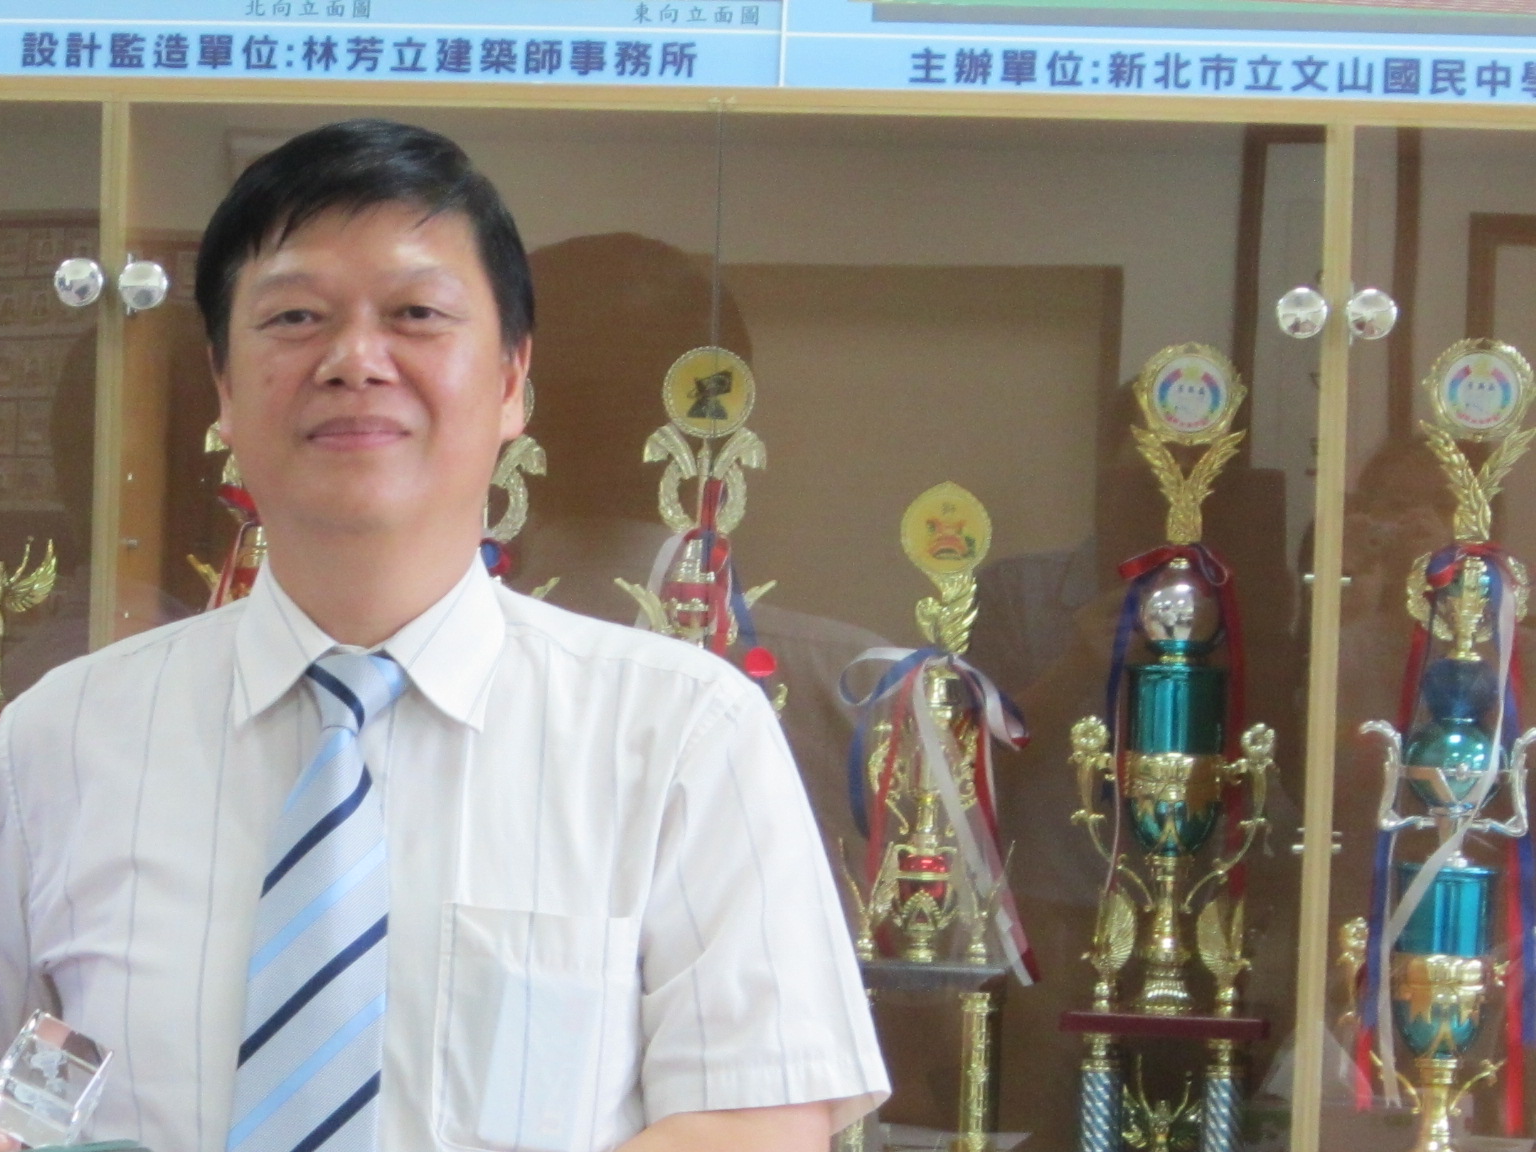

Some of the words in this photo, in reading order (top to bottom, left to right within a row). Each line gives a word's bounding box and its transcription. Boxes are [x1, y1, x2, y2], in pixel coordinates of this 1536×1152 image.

[245, 0, 370, 18] 北向立面圖
[633, 1, 759, 25] 東向立面圖
[20, 30, 699, 79] 設計監造單位:林芳立建築師事務所
